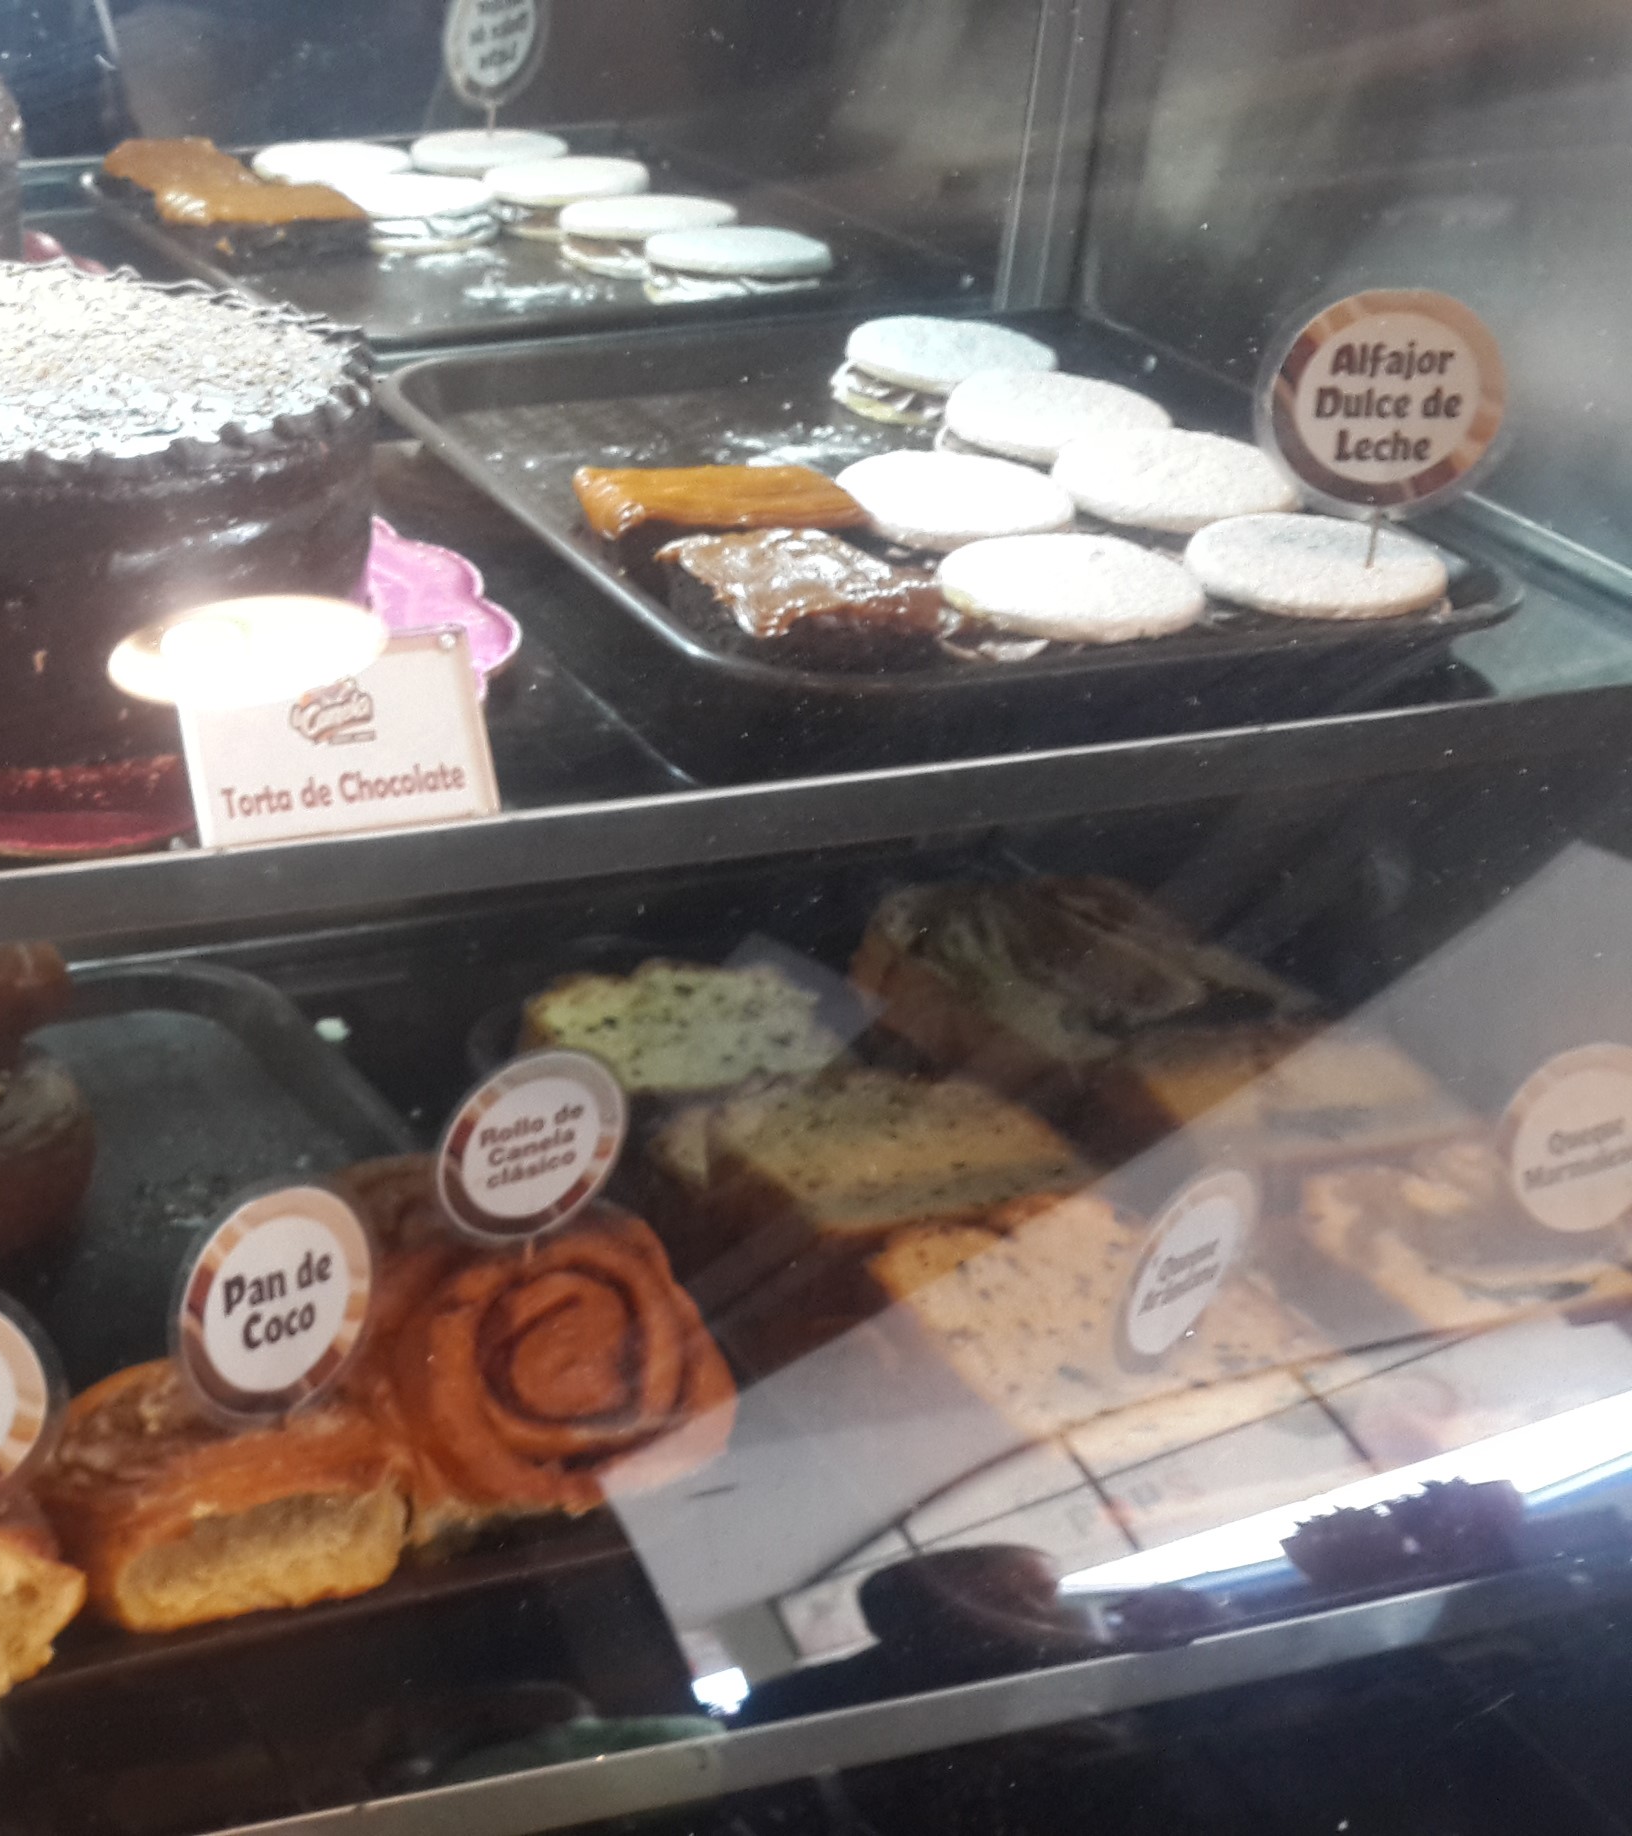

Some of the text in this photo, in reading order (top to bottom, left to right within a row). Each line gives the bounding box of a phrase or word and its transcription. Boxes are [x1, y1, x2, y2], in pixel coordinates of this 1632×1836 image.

[1330, 340, 1455, 381] Alfajor
[1315, 386, 1463, 418] Dulce de
[1333, 430, 1432, 462] Leche
[221, 762, 466, 819] Torta de Chocolate
[479, 1104, 584, 1148] Rollo de
[487, 1128, 576, 1167] Canela
[223, 1249, 332, 1317] Pan de
[241, 1302, 316, 1350] Coco
